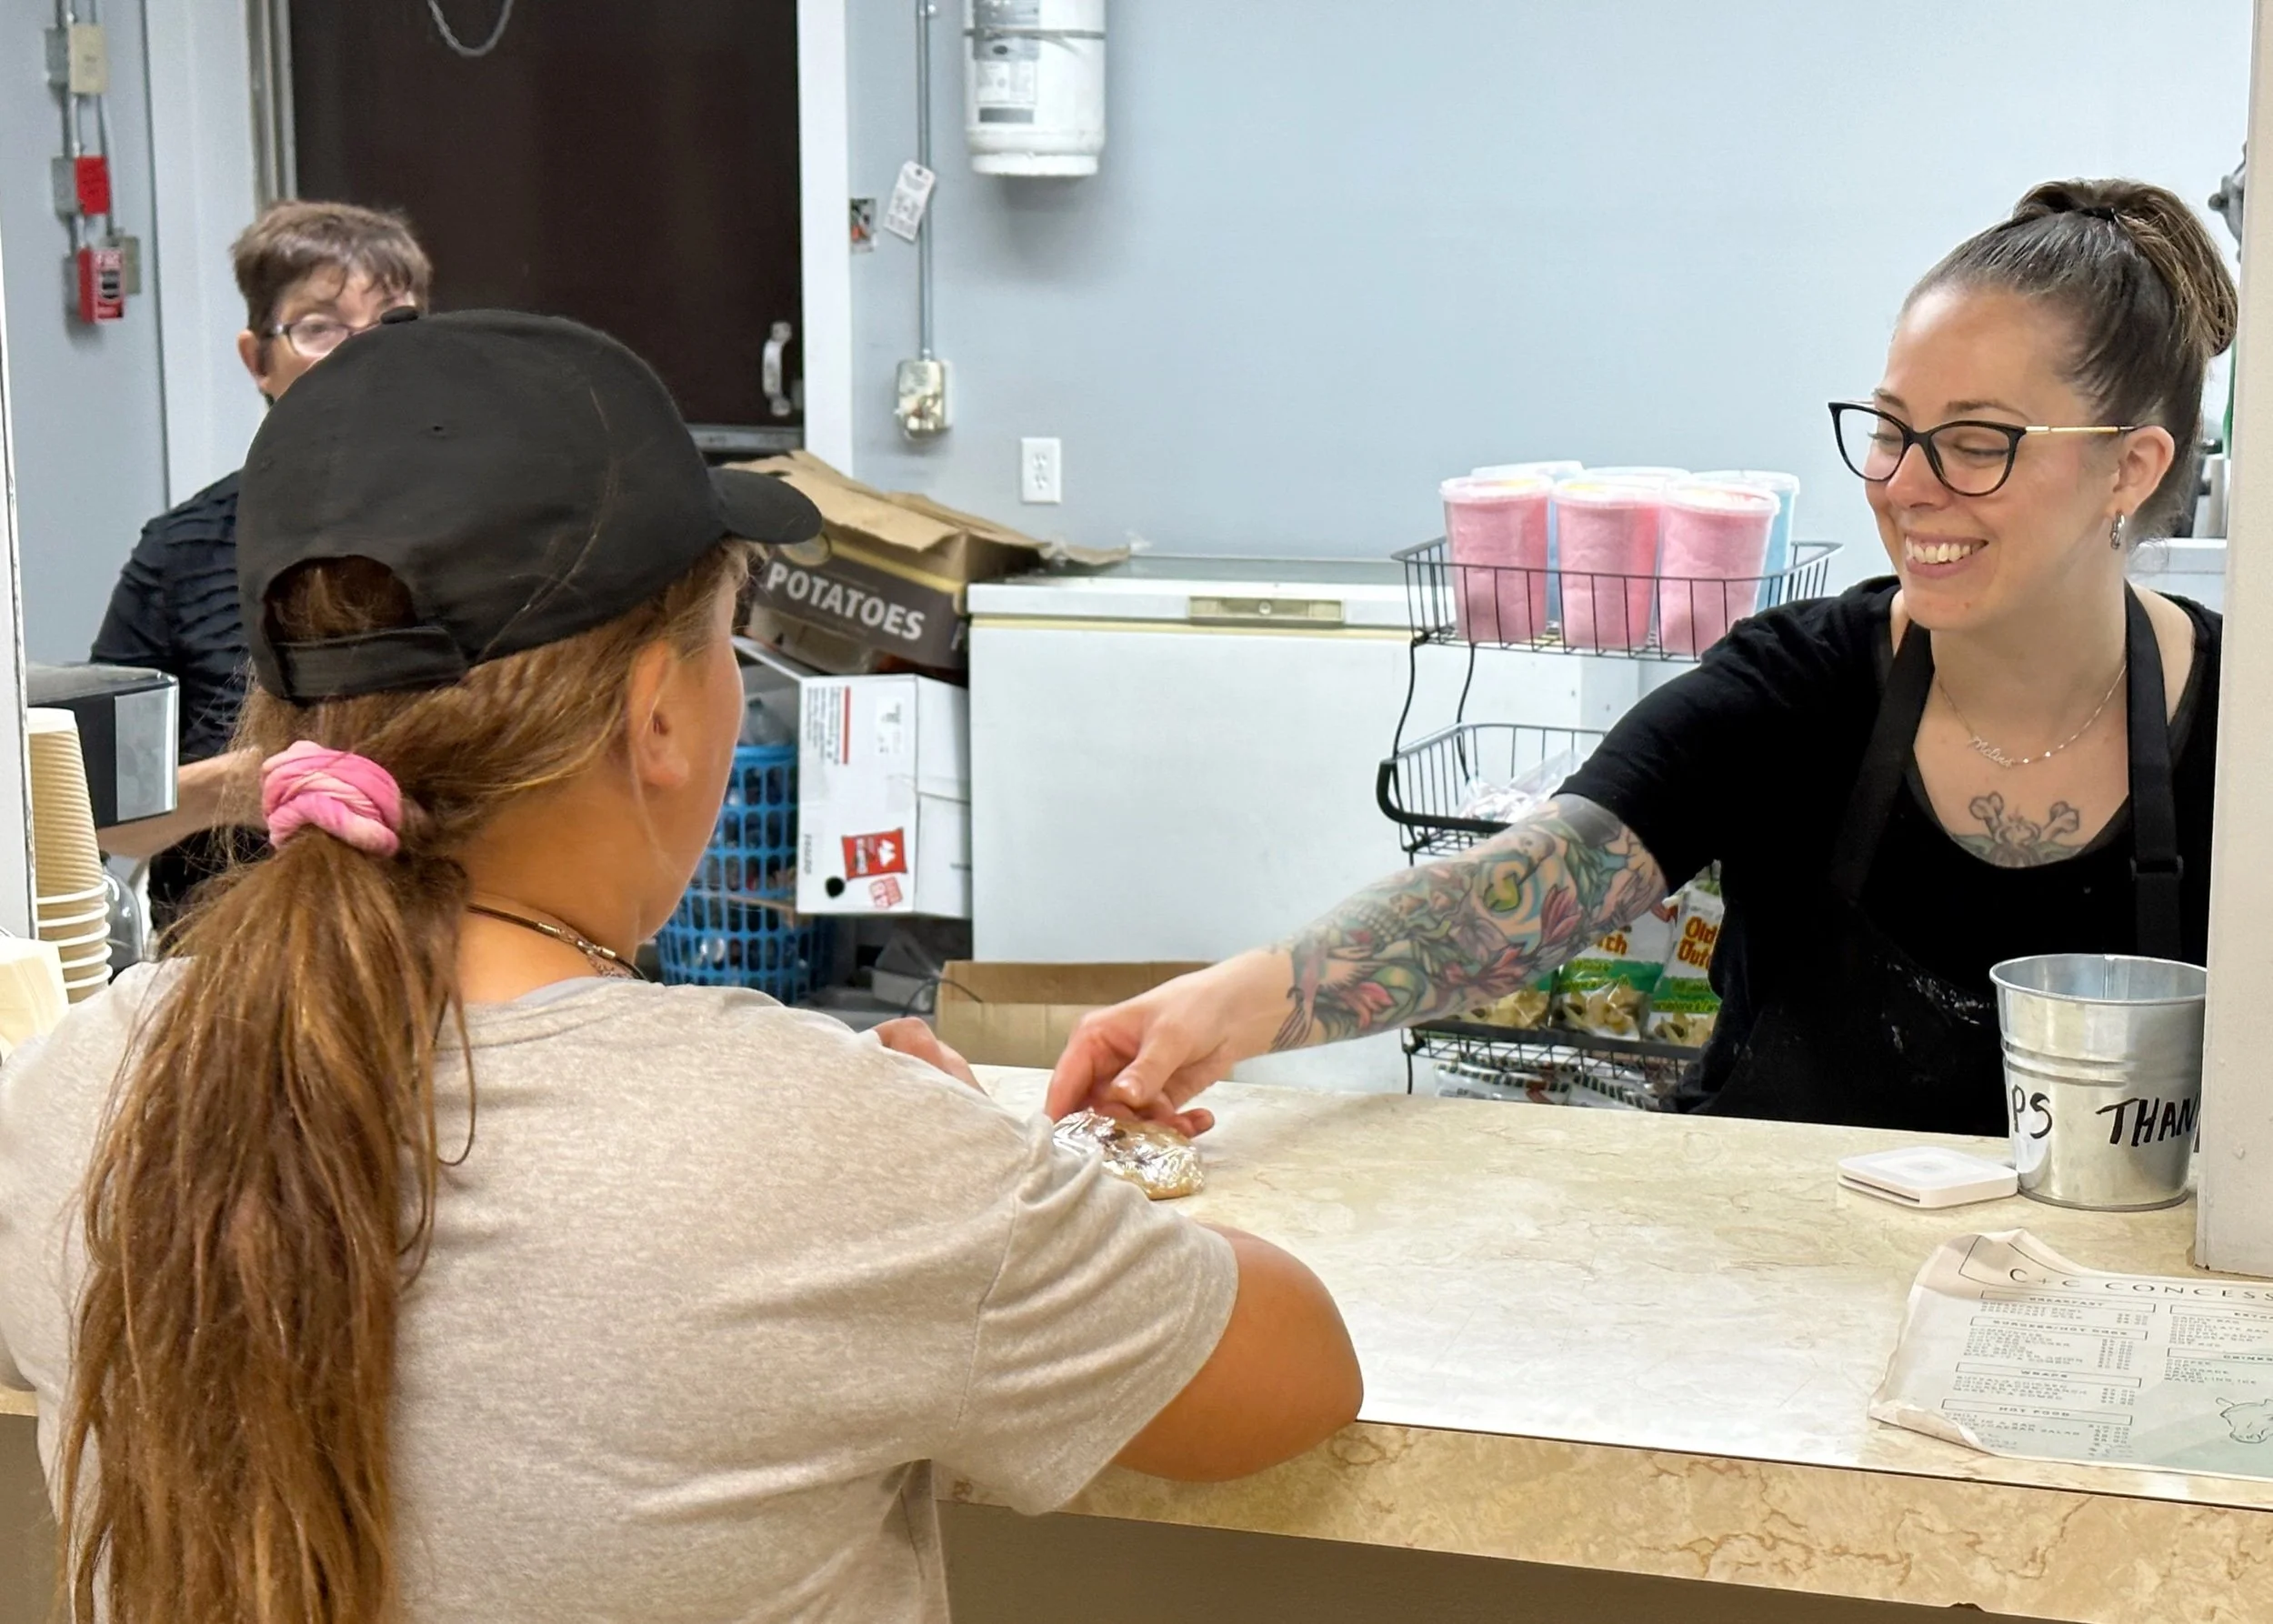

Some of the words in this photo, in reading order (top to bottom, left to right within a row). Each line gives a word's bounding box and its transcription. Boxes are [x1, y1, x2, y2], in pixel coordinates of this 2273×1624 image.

[767, 561, 926, 640] POTATOES
[1686, 916, 1717, 944] Old
[2011, 1084, 2053, 1139] PS
[2095, 1092, 2200, 1153] THAN
[2105, 1280, 2273, 1301] CONCESS
